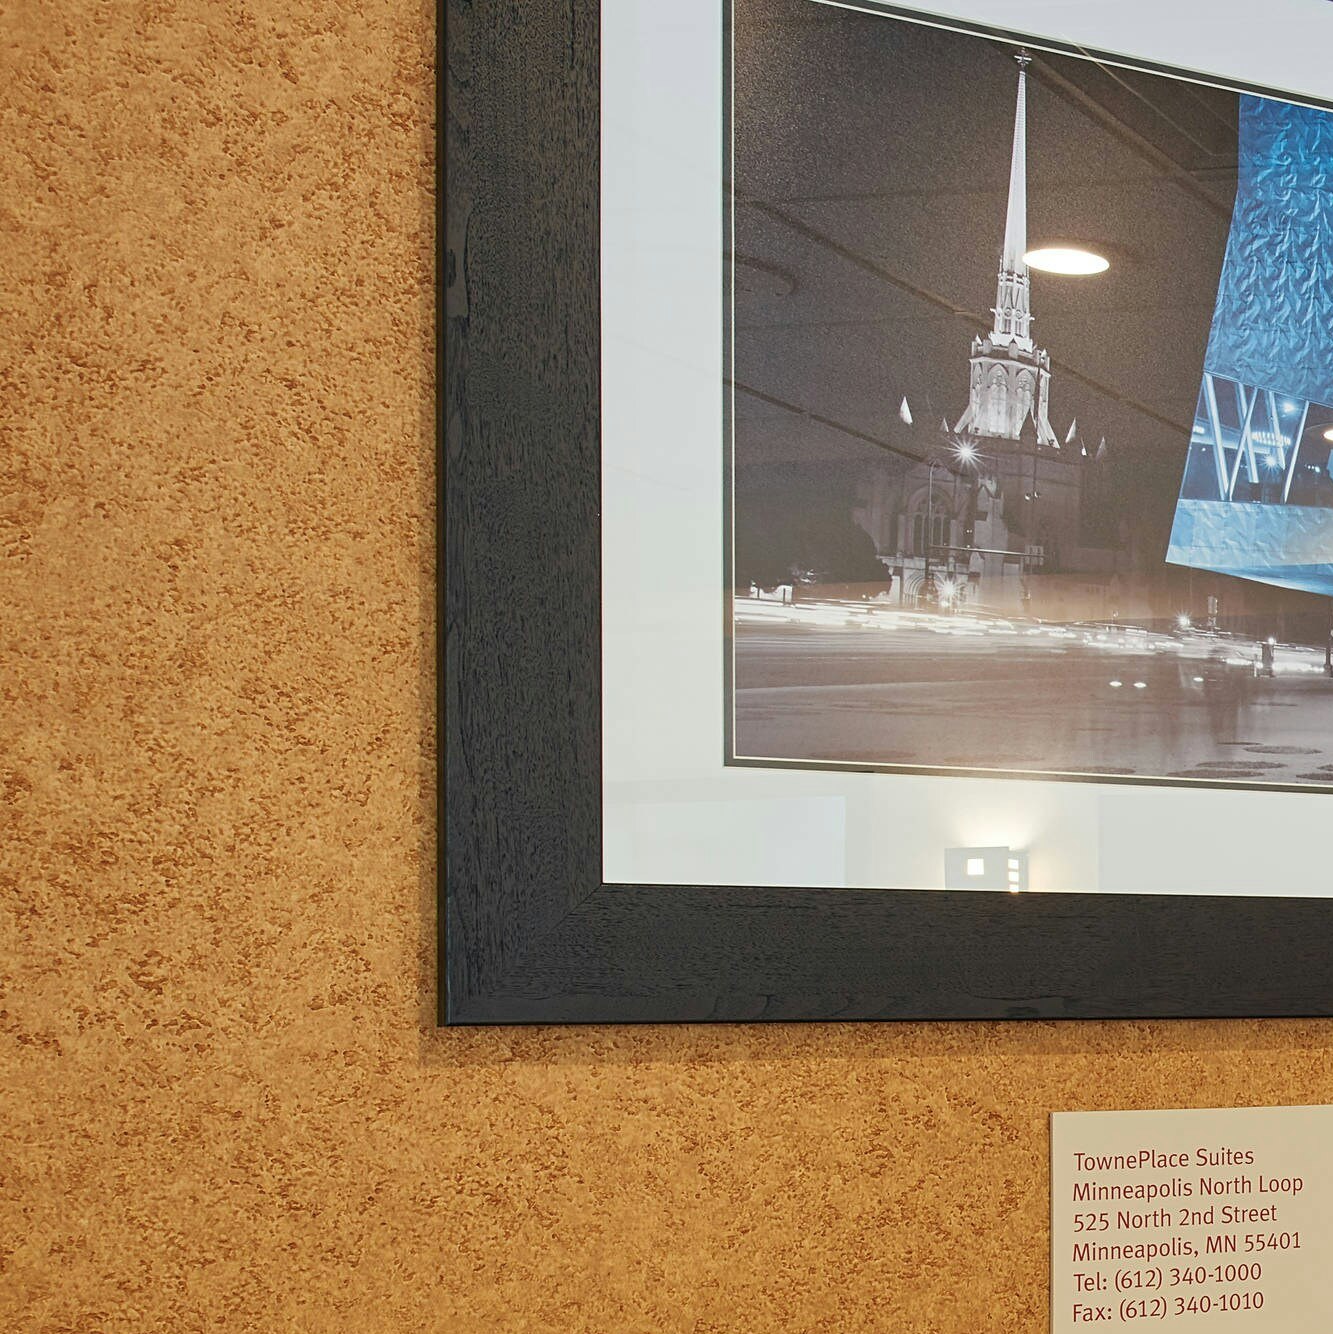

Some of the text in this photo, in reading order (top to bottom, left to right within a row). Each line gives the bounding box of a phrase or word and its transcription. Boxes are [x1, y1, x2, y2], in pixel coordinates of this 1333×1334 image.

[1074, 1147, 1254, 1171] TownePlace Suites
[1073, 1175, 1303, 1202] Minneapolis North Loop
[1074, 1204, 1278, 1232] 525 North 2nd Street
[1073, 1232, 1301, 1263] Minneapolis, MN 55401
[1074, 1263, 1262, 1293] Tel: (612) 340-1000
[1073, 1292, 1264, 1323] Fax: (612) 340-1010
